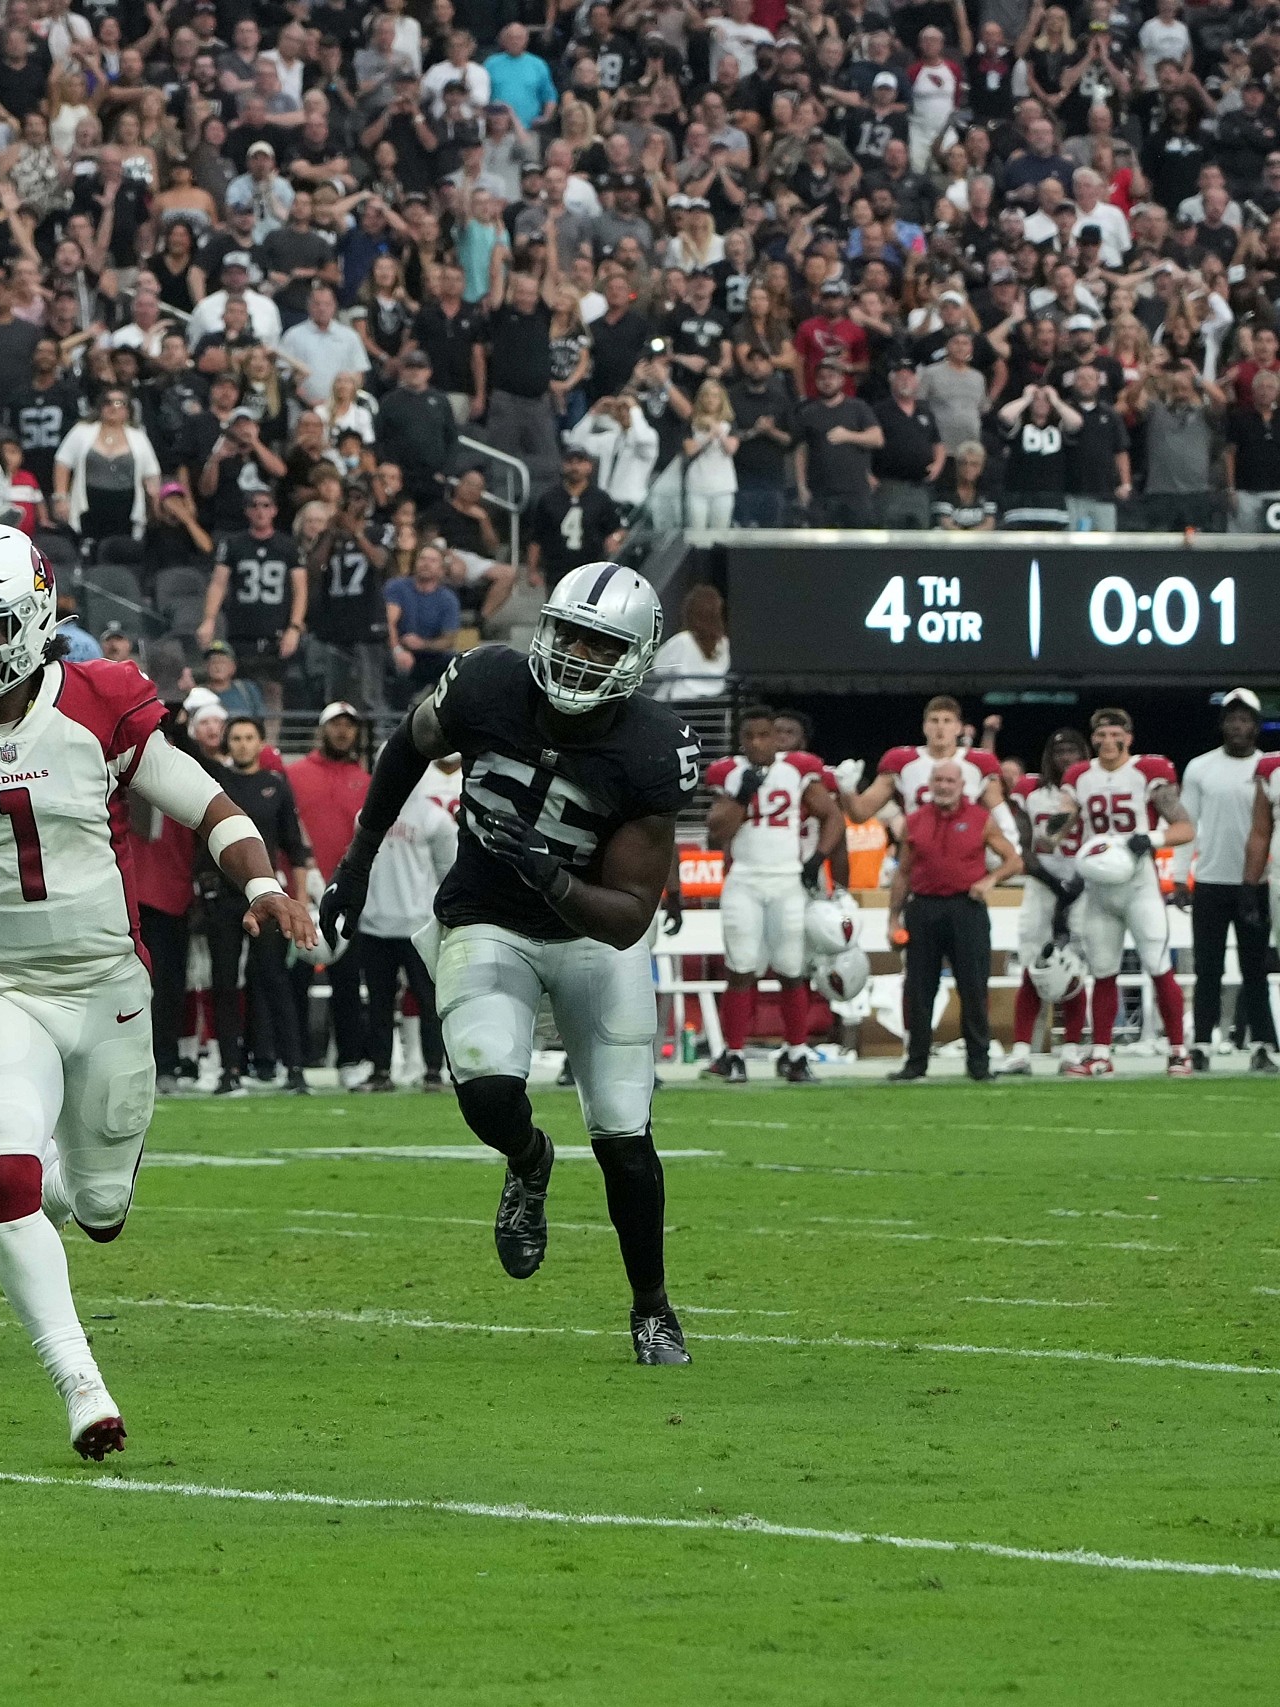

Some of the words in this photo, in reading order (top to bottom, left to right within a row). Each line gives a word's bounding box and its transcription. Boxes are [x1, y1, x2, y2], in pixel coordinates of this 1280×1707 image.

[20, 406, 63, 450] 52
[560, 505, 584, 550] 4
[236, 559, 287, 604] 39
[328, 553, 368, 596] 17
[865, 575, 912, 644] 4
[917, 575, 961, 607] TH
[917, 611, 983, 643] QTR
[1089, 575, 1236, 646] 0:01
[465, 751, 613, 863] 55
[1088, 794, 1136, 834] 85
